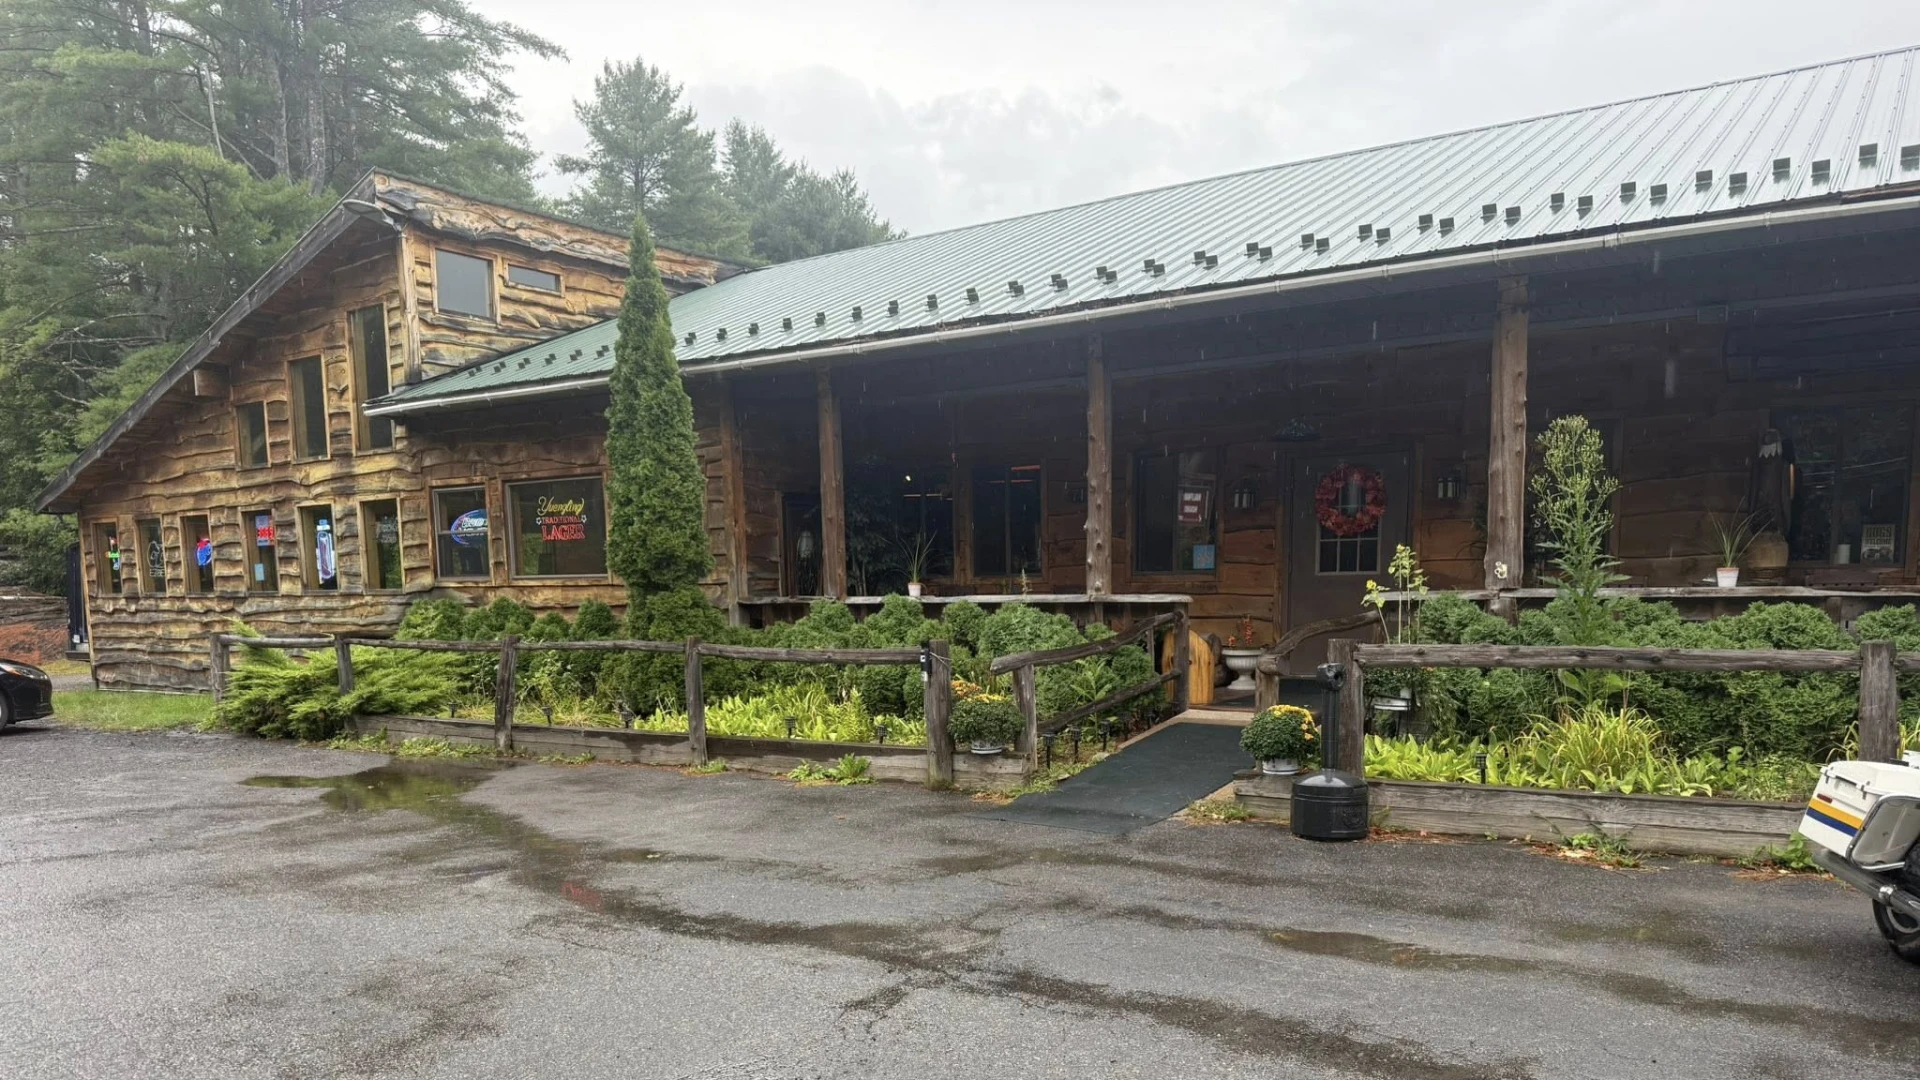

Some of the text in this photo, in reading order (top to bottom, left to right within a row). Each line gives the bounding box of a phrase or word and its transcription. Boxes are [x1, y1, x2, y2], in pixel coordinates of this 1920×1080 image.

[537, 496, 585, 516] Yuengling
[541, 515, 582, 524] TRADITIONAL
[541, 524, 586, 541] LAGER
